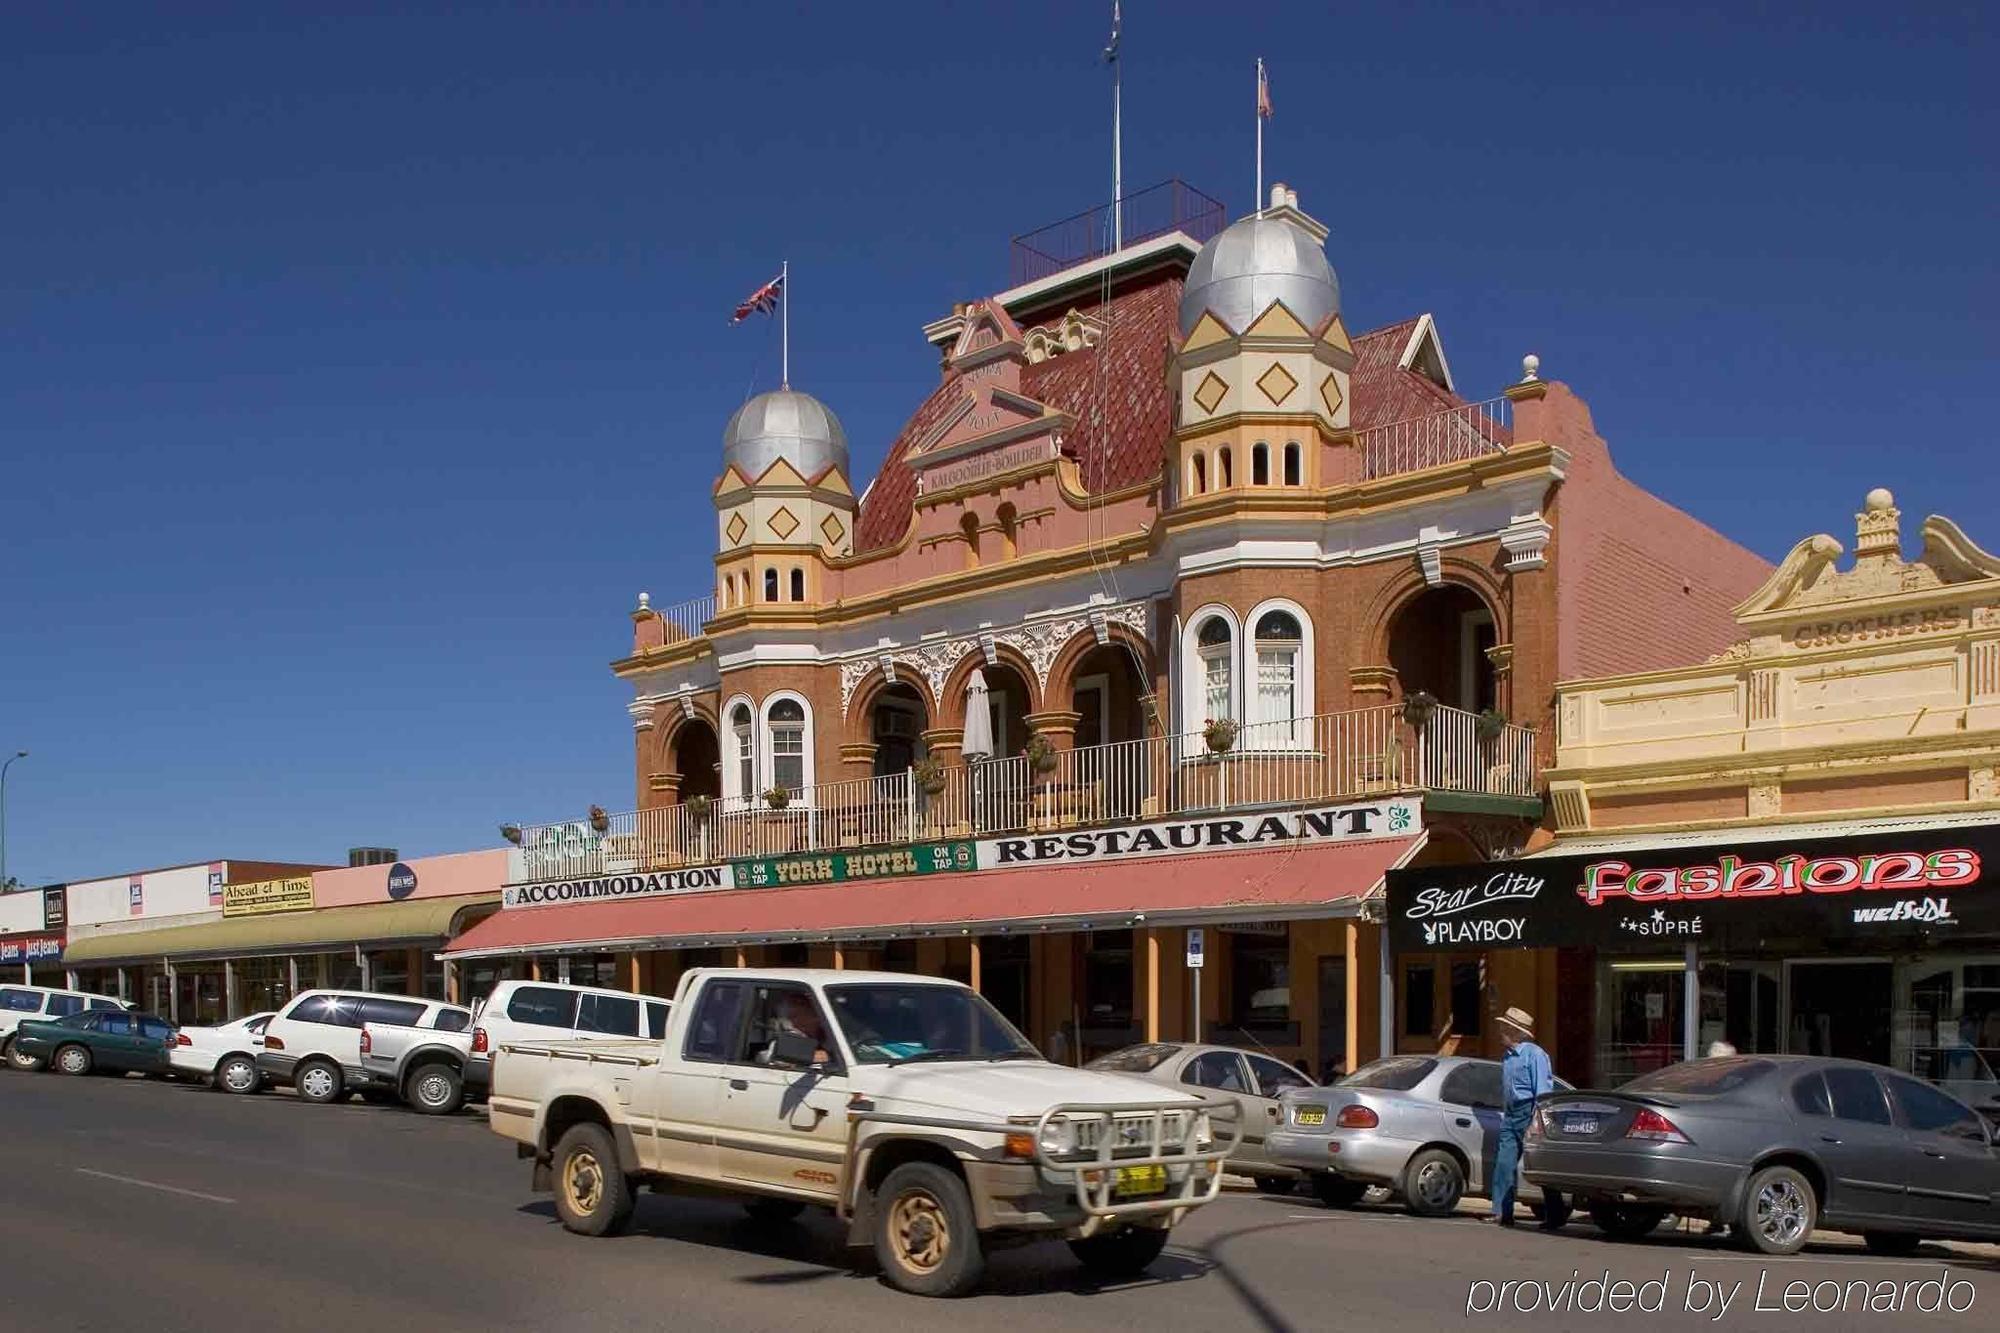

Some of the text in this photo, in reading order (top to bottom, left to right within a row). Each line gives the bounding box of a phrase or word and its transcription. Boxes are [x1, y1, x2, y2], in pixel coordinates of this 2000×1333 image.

[996, 807, 1381, 863] RESTAURANT
[933, 847, 949, 858] ON
[752, 864, 766, 874] ON
[774, 859, 834, 883] YORK
[845, 851, 918, 877] HOTEL
[932, 858, 953, 870] TAP
[225, 879, 310, 898] Ahead of Time
[516, 868, 723, 904] ACCOMMODATION
[751, 875, 768, 885] TAP
[1406, 872, 1545, 919] Star City
[1437, 918, 1527, 944] PLAYBOY
[1639, 915, 1703, 936] SUPRÉ
